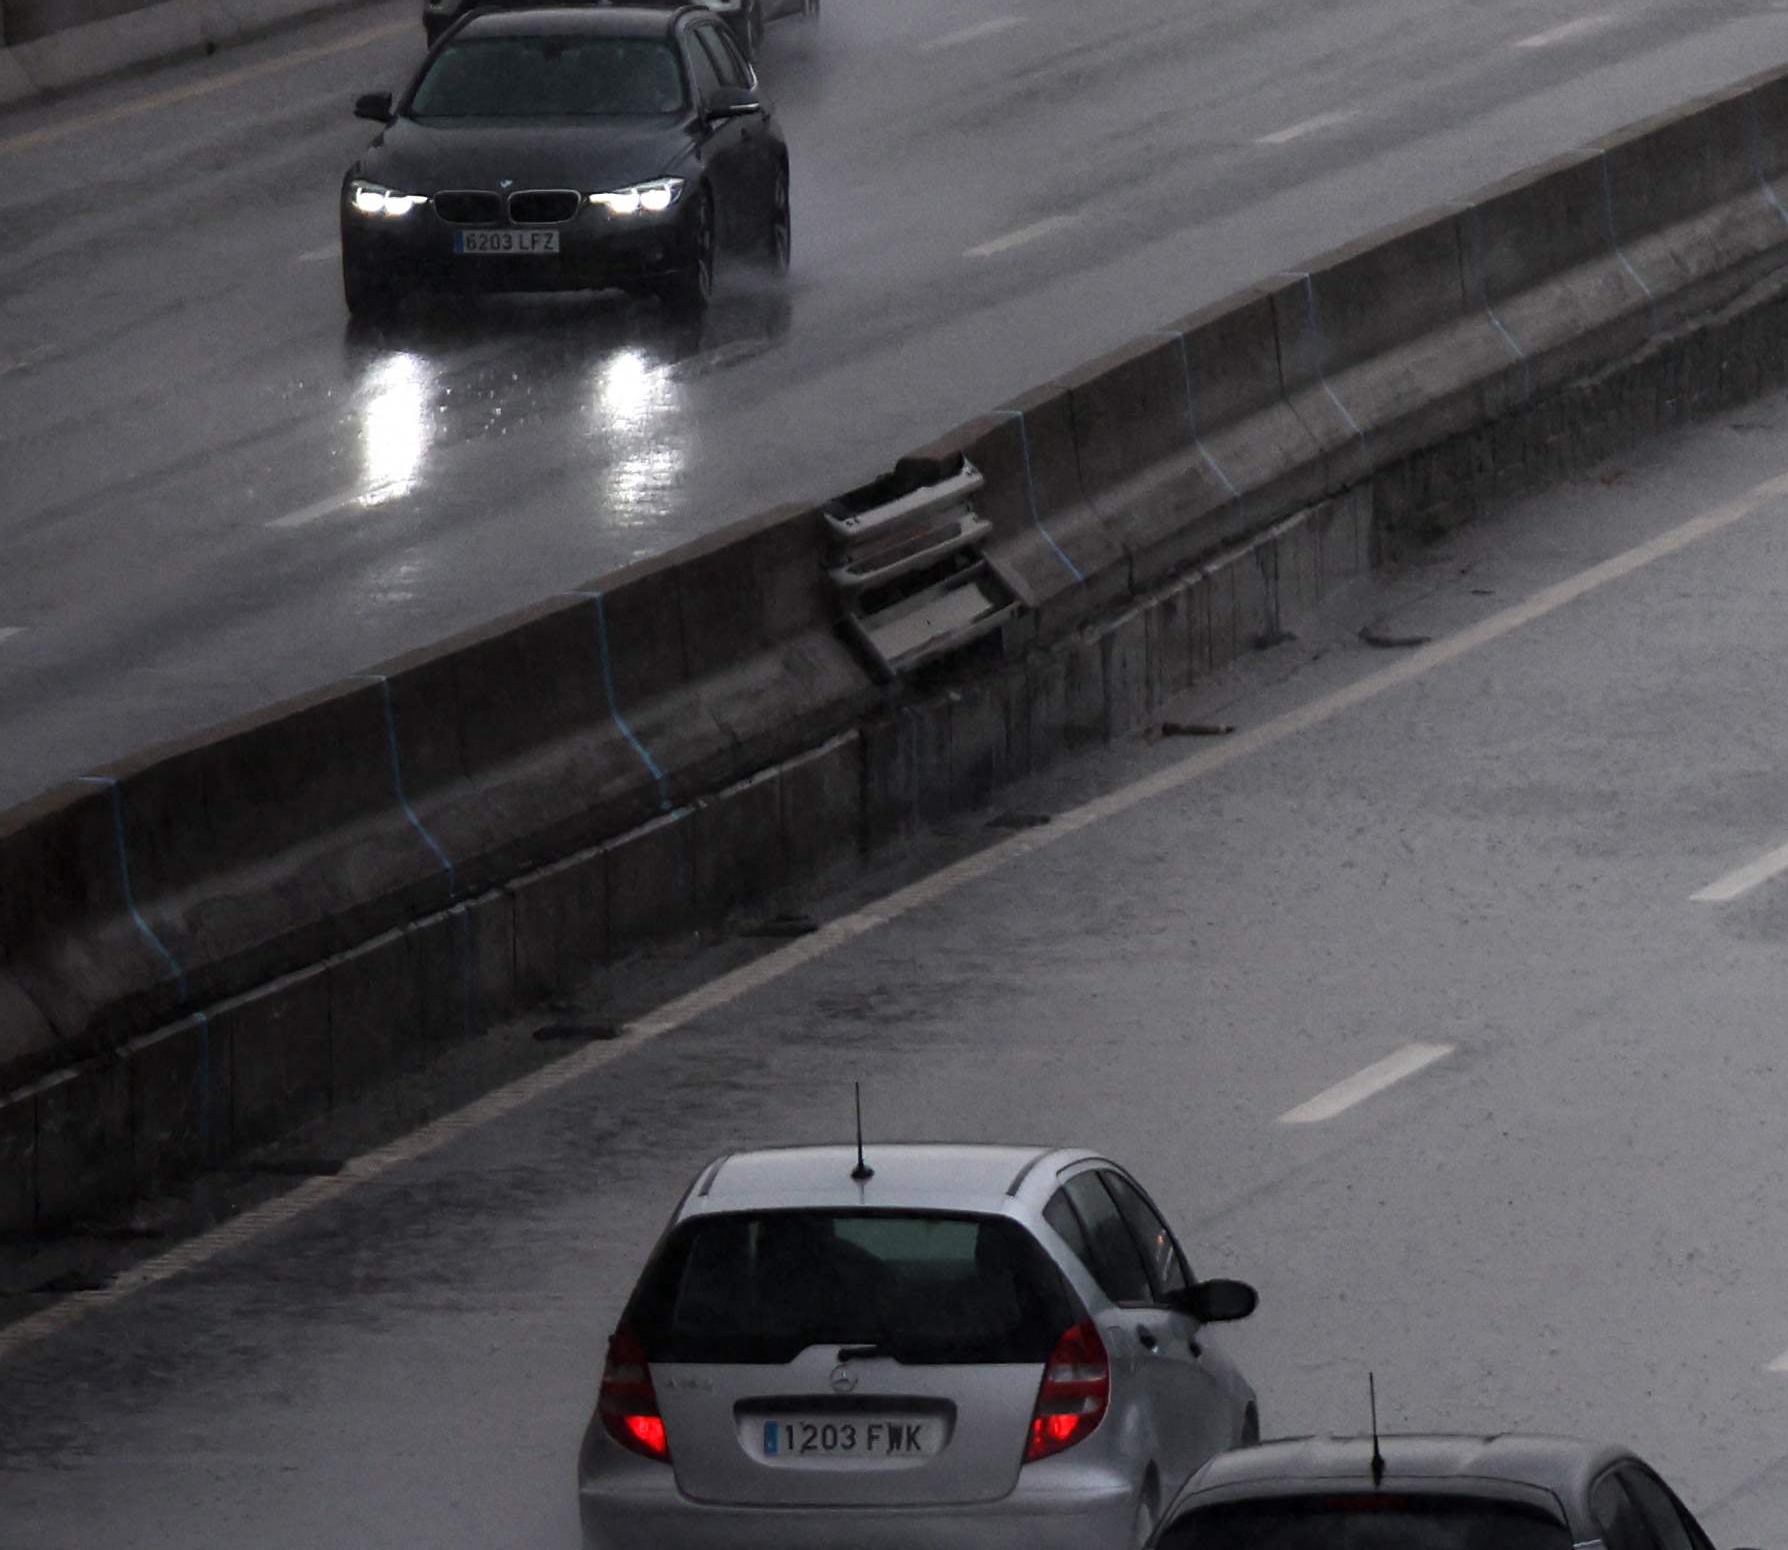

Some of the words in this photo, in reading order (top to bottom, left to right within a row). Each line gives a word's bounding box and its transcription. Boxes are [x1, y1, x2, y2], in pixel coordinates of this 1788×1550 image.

[465, 233, 513, 252] 6203
[518, 233, 554, 252] LFZ
[784, 1424, 856, 1451] 1203
[865, 1424, 921, 1451] FWK
